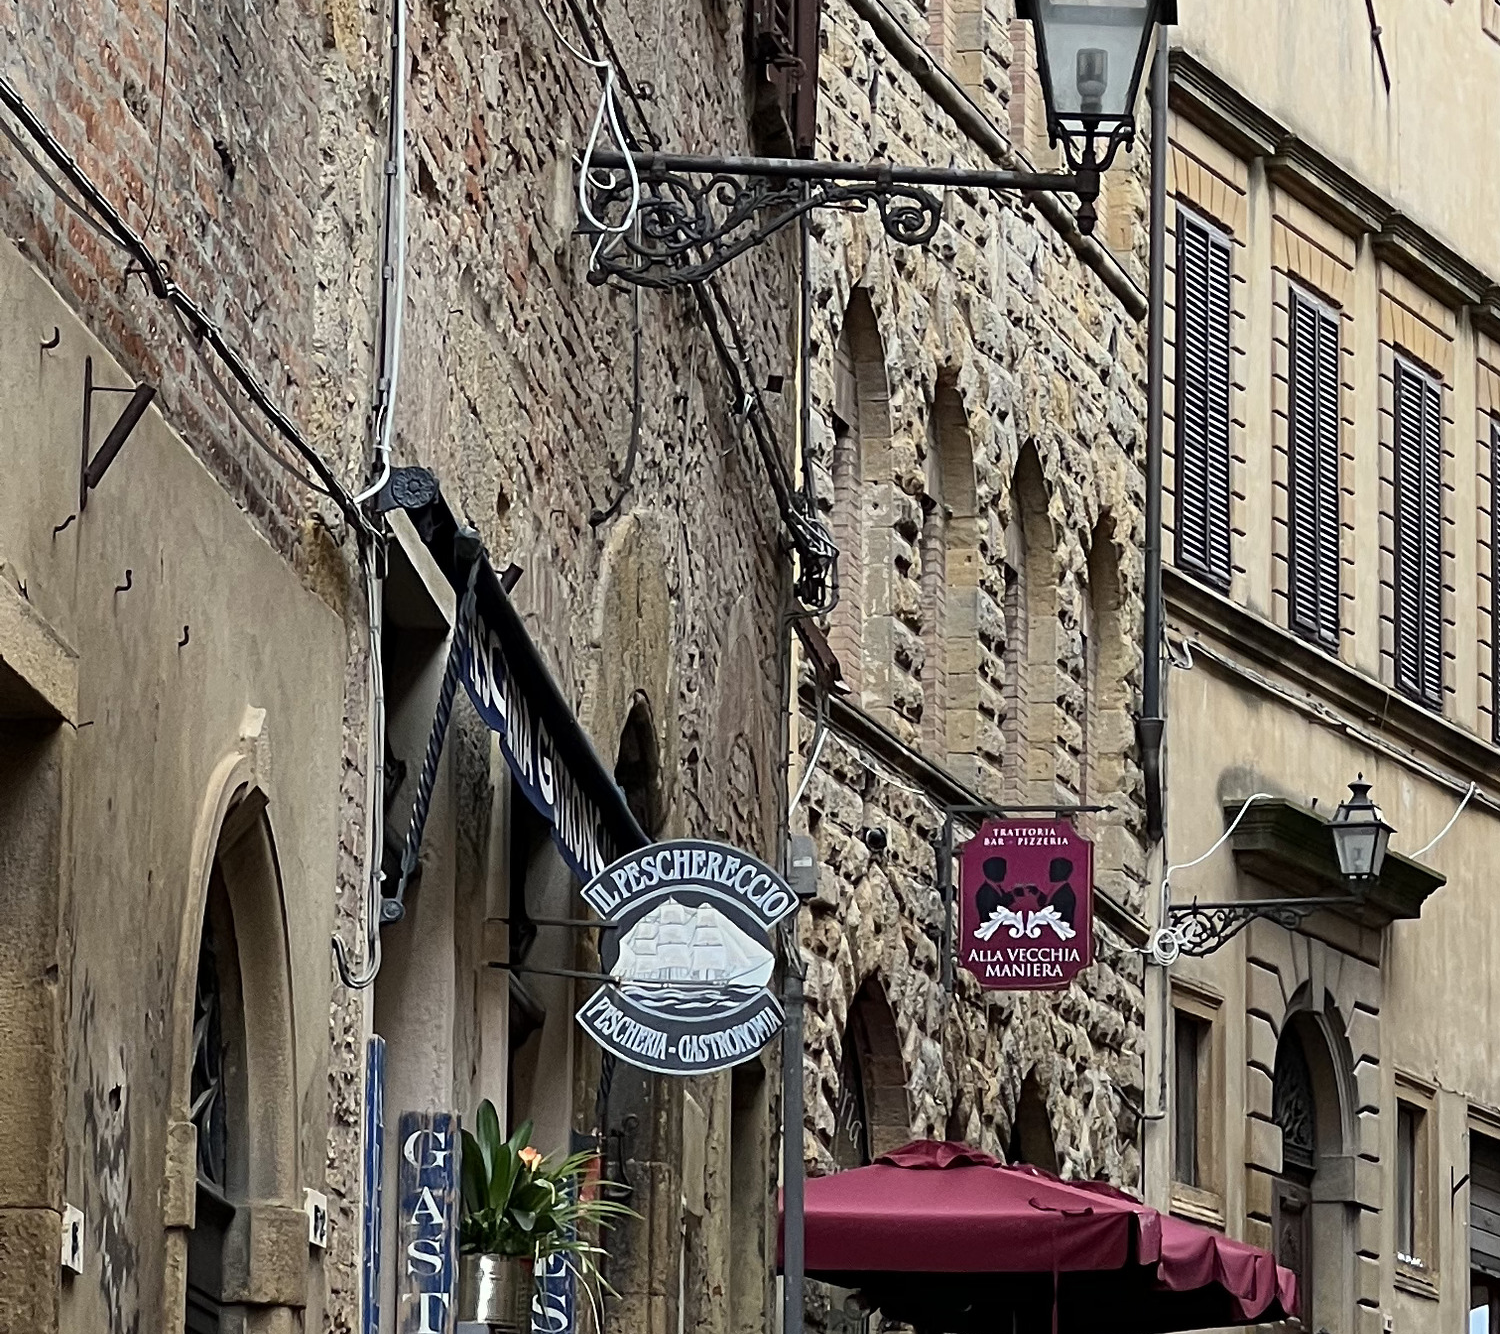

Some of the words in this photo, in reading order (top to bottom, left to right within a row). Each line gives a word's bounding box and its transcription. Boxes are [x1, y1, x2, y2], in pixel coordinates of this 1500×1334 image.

[993, 827, 1057, 837] TRATTORIA
[984, 837, 1005, 846] BAR
[1017, 837, 1069, 846] PIZZERIA
[588, 882, 622, 914] IL
[609, 848, 791, 918] PESCHERECCIO
[968, 948, 1004, 963] ALLA
[1006, 947, 1081, 963] VECCHIA
[985, 963, 1063, 978] MANIERA
[586, 995, 668, 1061] PESCHERIA
[677, 1005, 784, 1063] GASTRONOMIA
